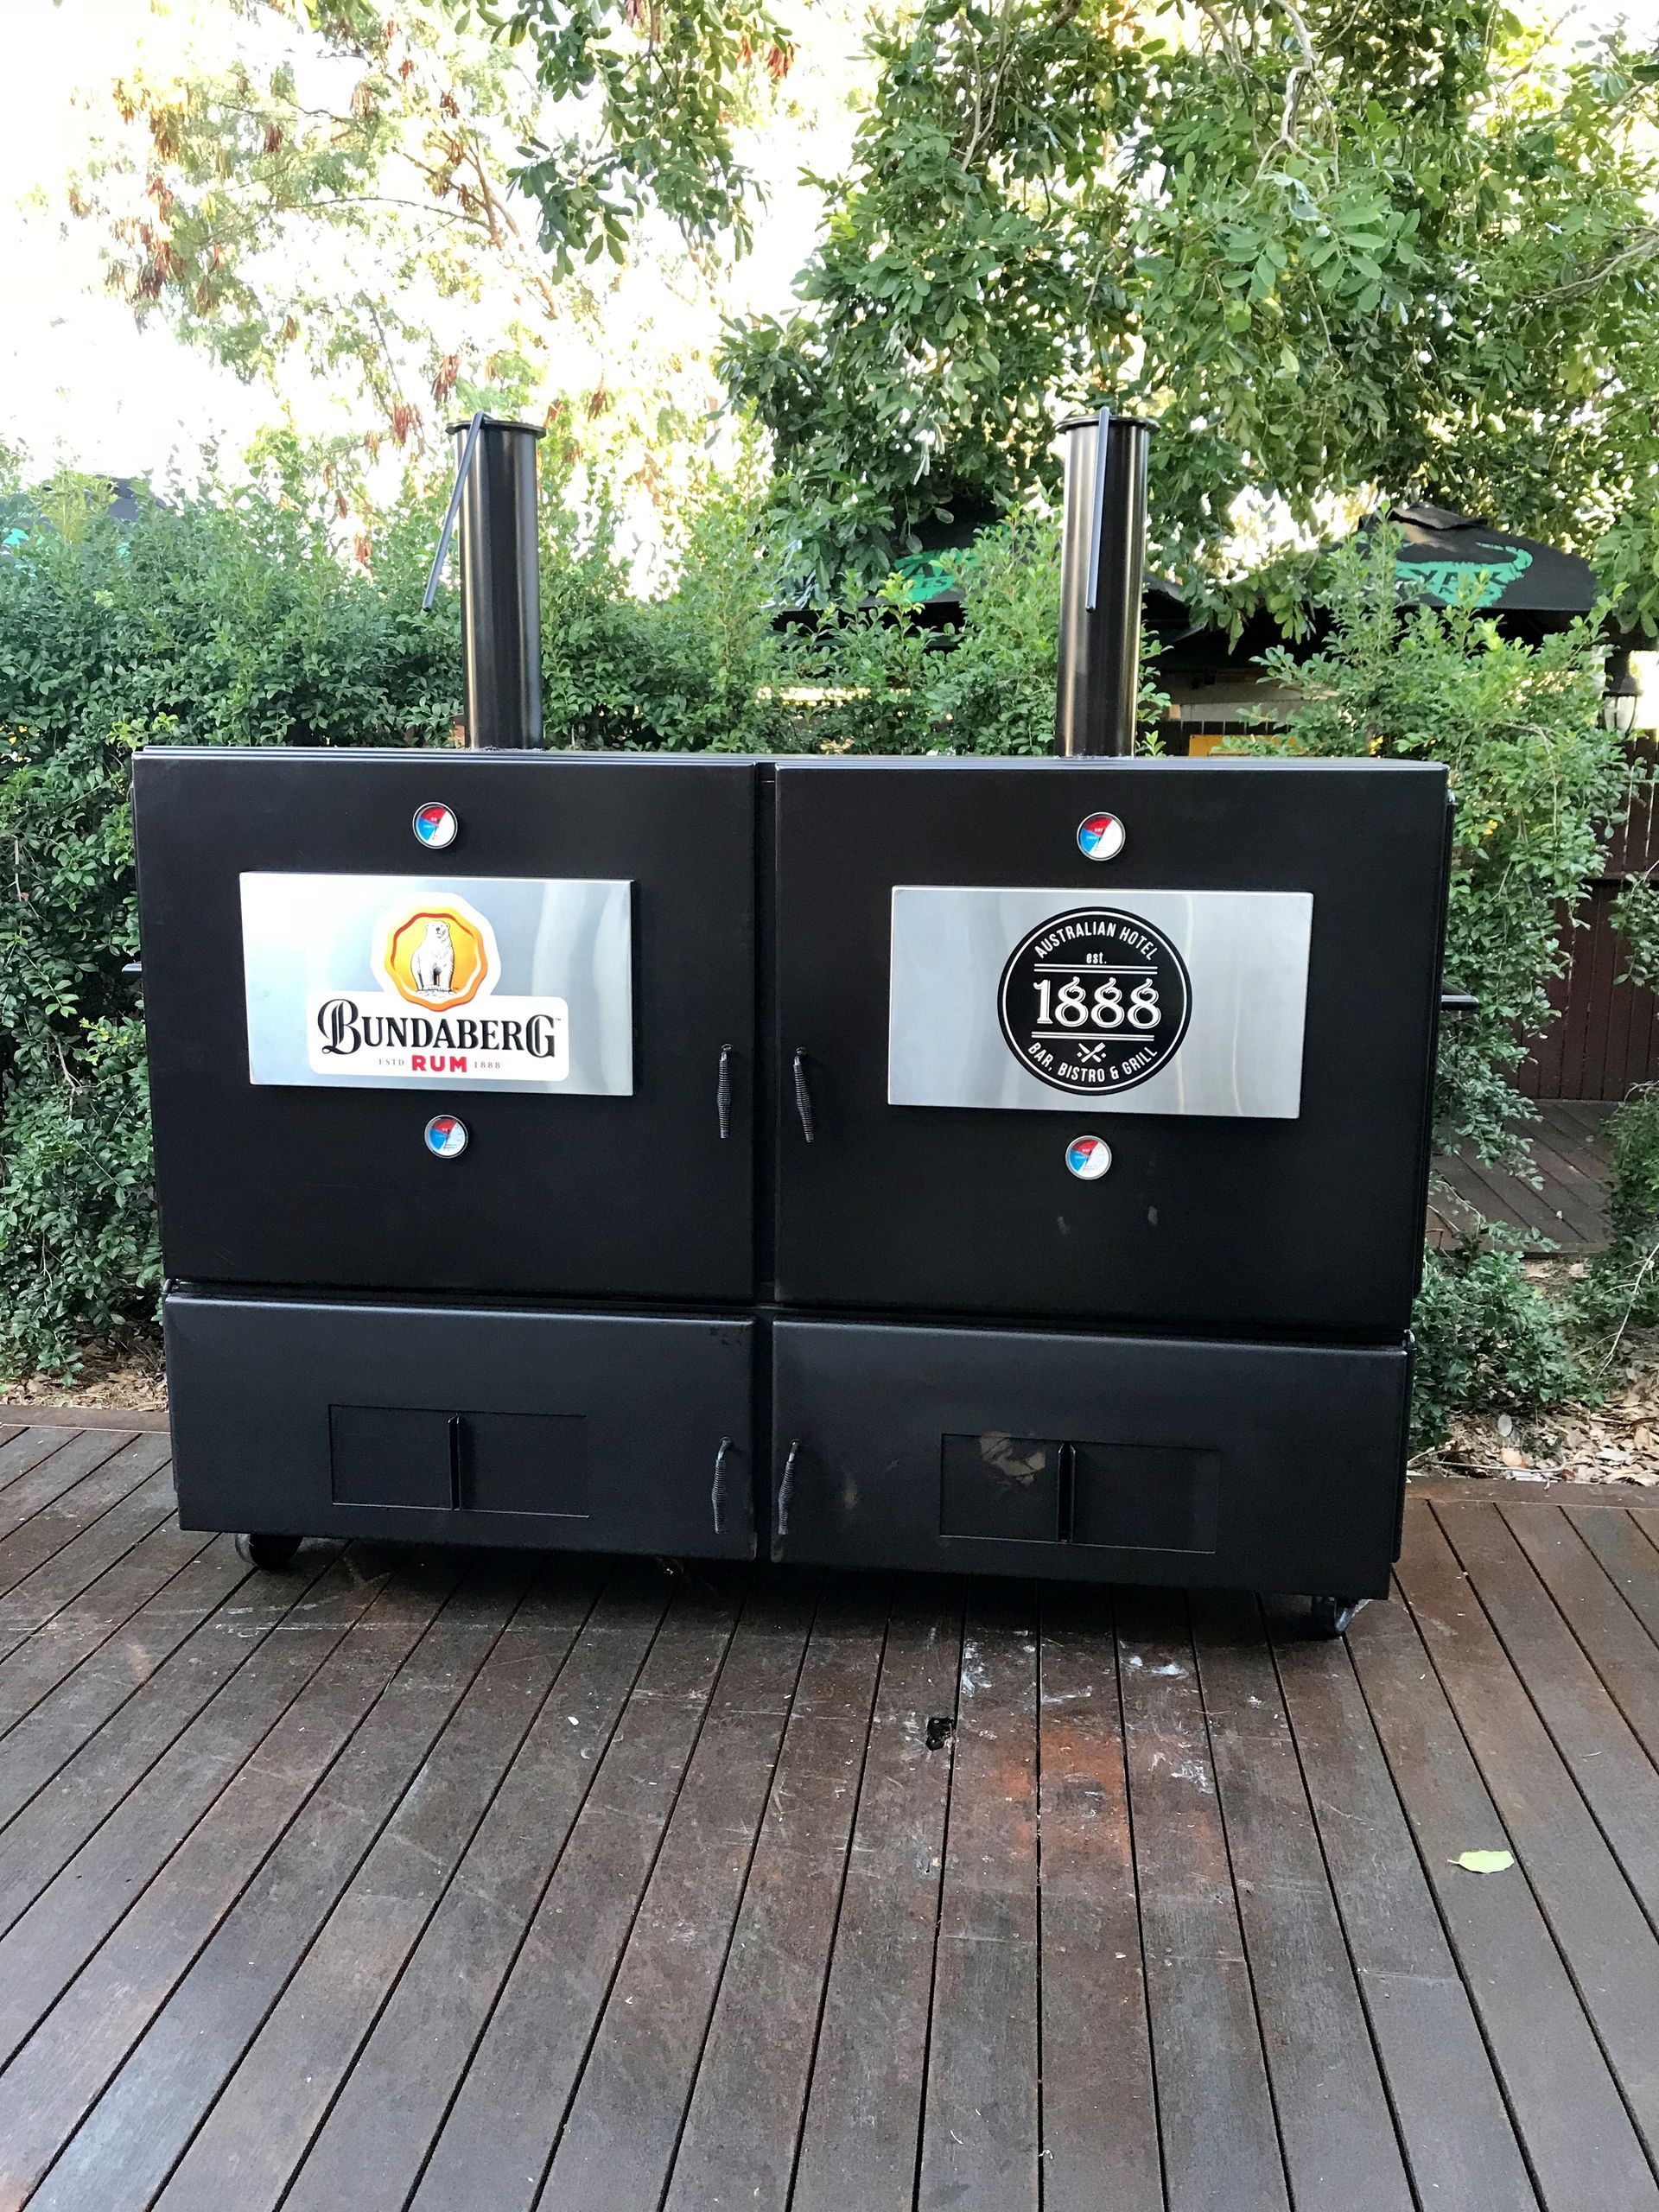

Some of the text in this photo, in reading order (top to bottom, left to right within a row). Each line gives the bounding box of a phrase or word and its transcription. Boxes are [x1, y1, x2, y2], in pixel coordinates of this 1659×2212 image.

[1033, 920, 1159, 962] AUSTRALIAN HOTEL
[1085, 951, 1108, 964] est.
[1033, 976, 1162, 1030] 1888
[316, 998, 556, 1058] BUNDABERG
[378, 1054, 501, 1073] ESTD RUM 1888
[1027, 1041, 1159, 1083] BAR, BISTRO & GRILL
